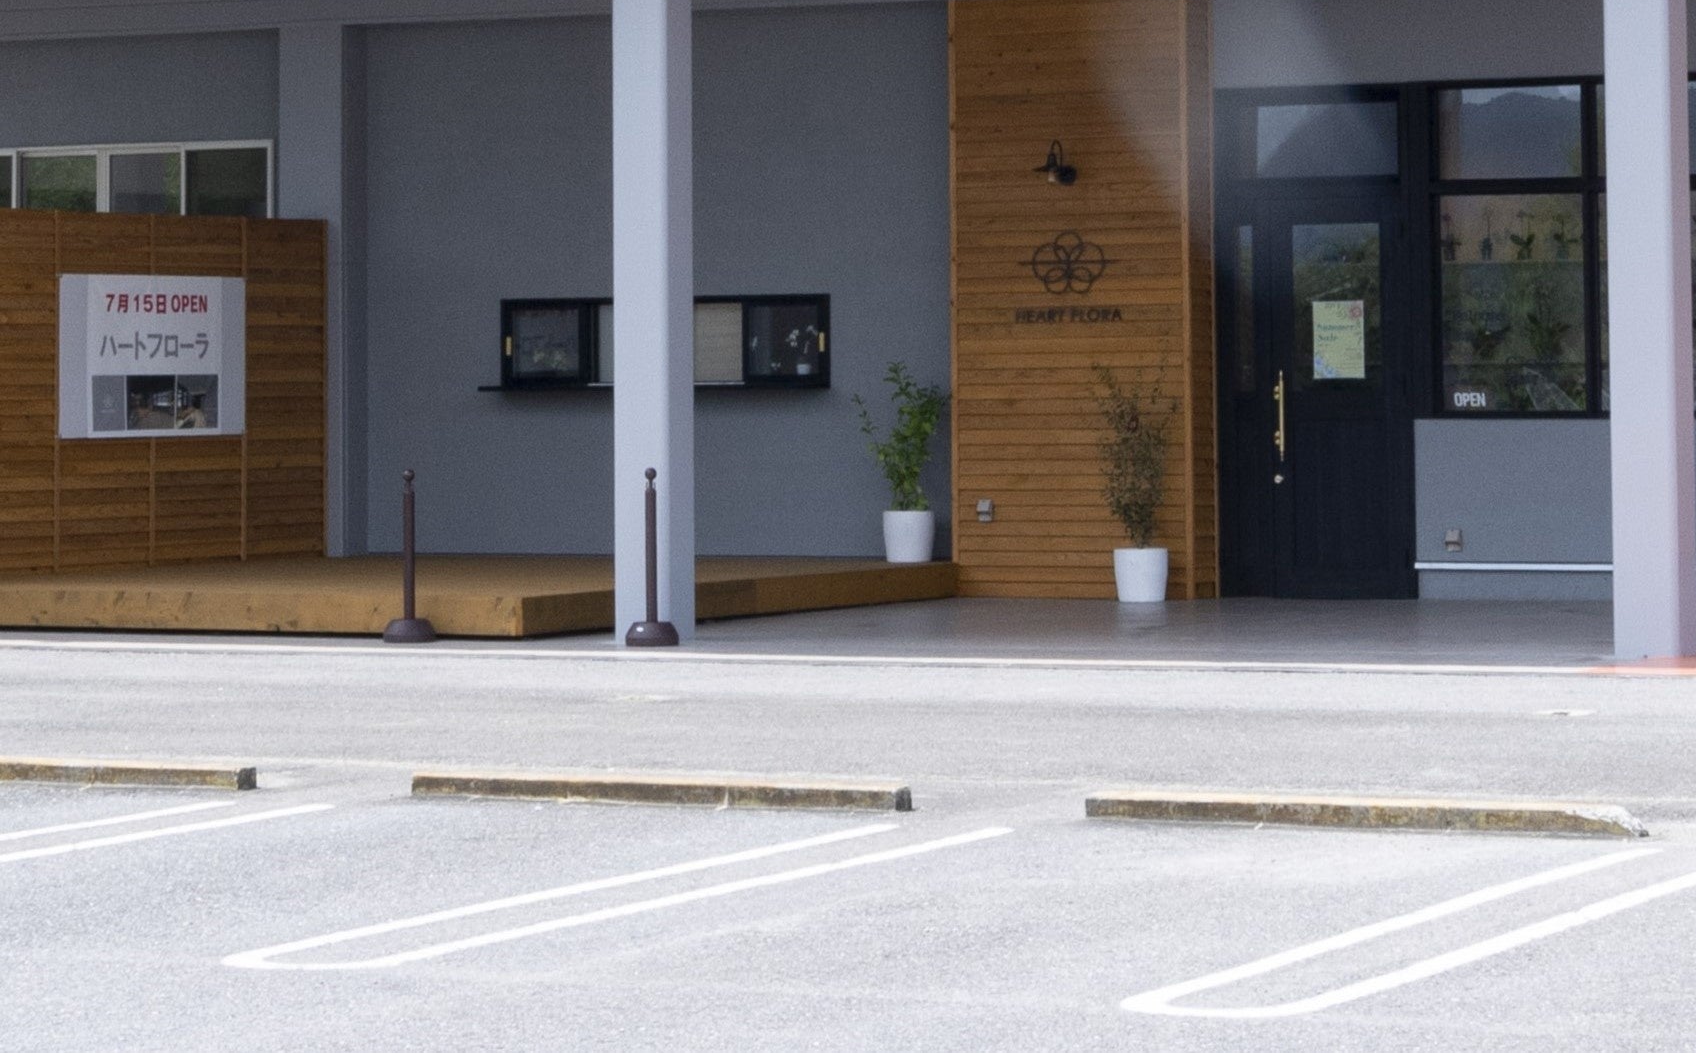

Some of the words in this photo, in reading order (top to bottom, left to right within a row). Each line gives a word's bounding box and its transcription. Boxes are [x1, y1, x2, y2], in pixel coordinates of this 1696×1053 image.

[171, 295, 208, 313] OPEN
[1015, 308, 1063, 324] HEART
[1071, 308, 1122, 323] FLORA
[100, 332, 210, 360] ハートフローラ
[1453, 391, 1487, 408] OPEN
